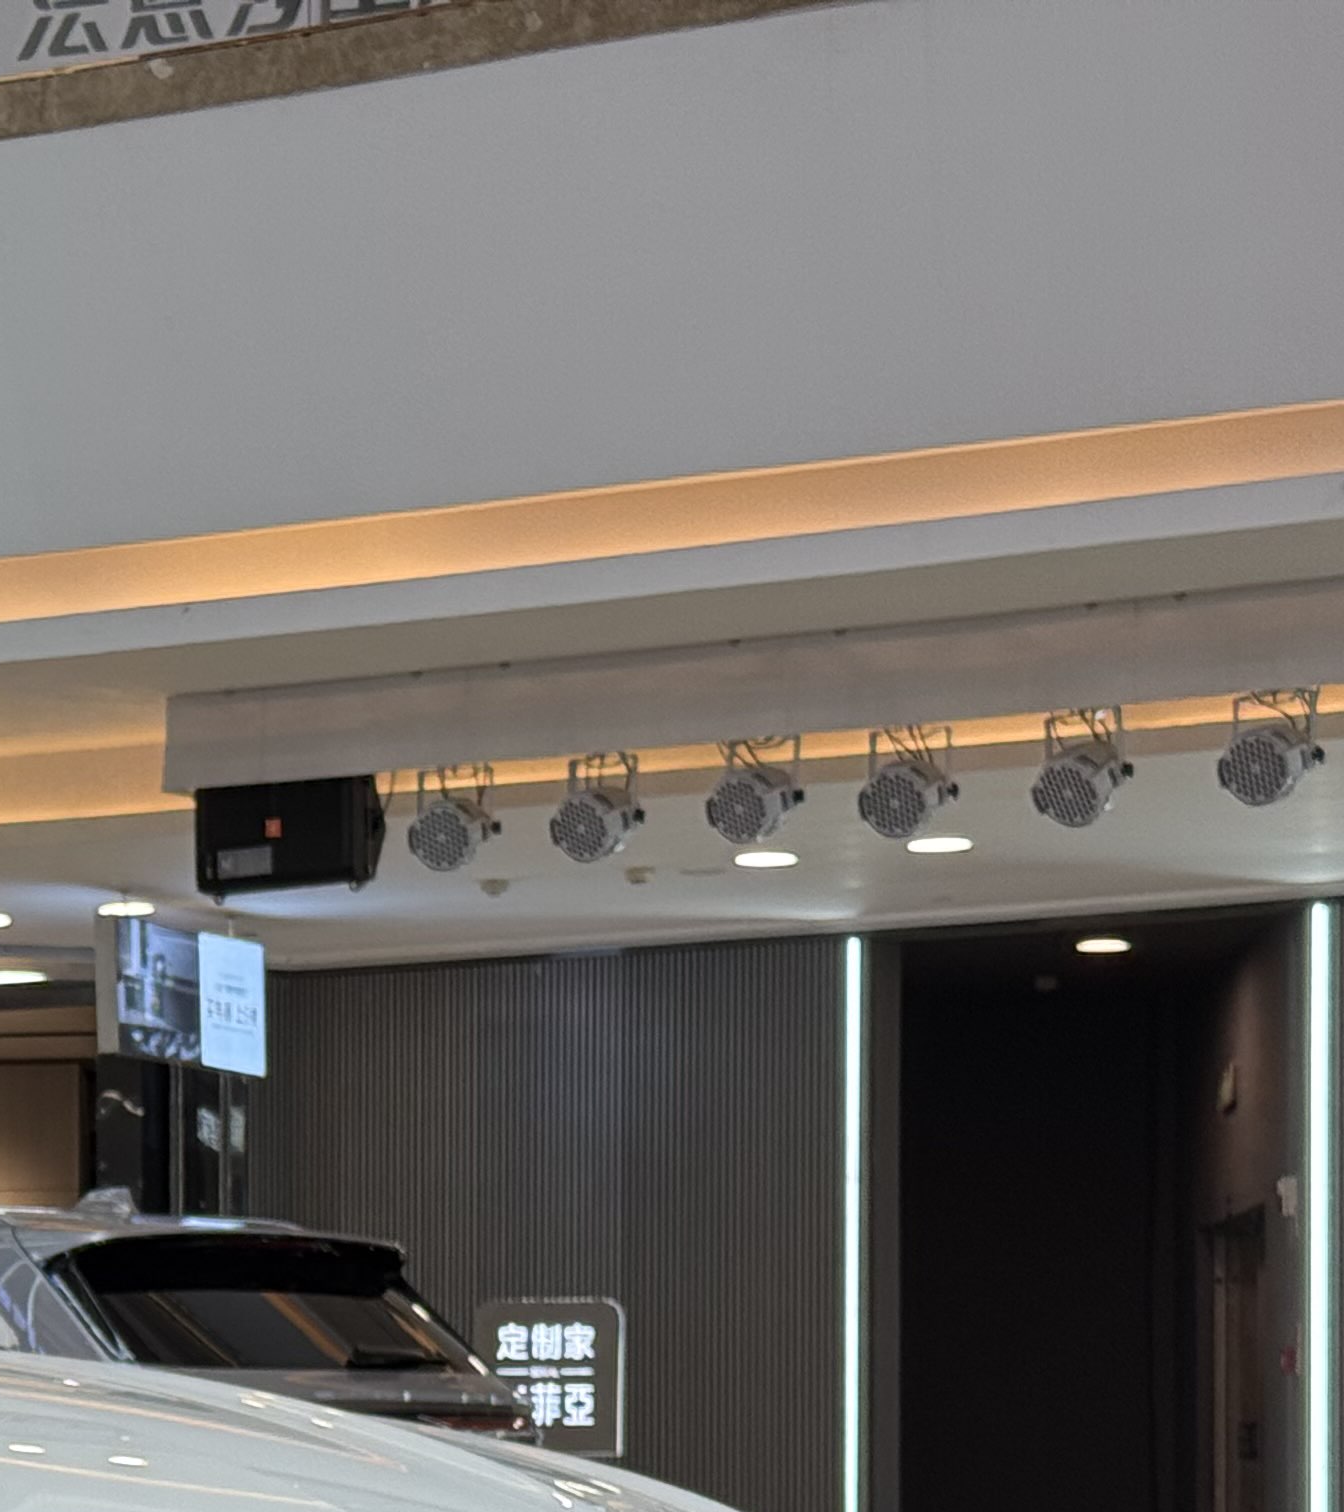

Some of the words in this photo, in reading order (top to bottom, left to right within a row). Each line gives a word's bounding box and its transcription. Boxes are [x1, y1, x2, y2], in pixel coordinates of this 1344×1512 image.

[496, 1321, 596, 1361] 定制家
[517, 1381, 596, 1428] 菲亞
